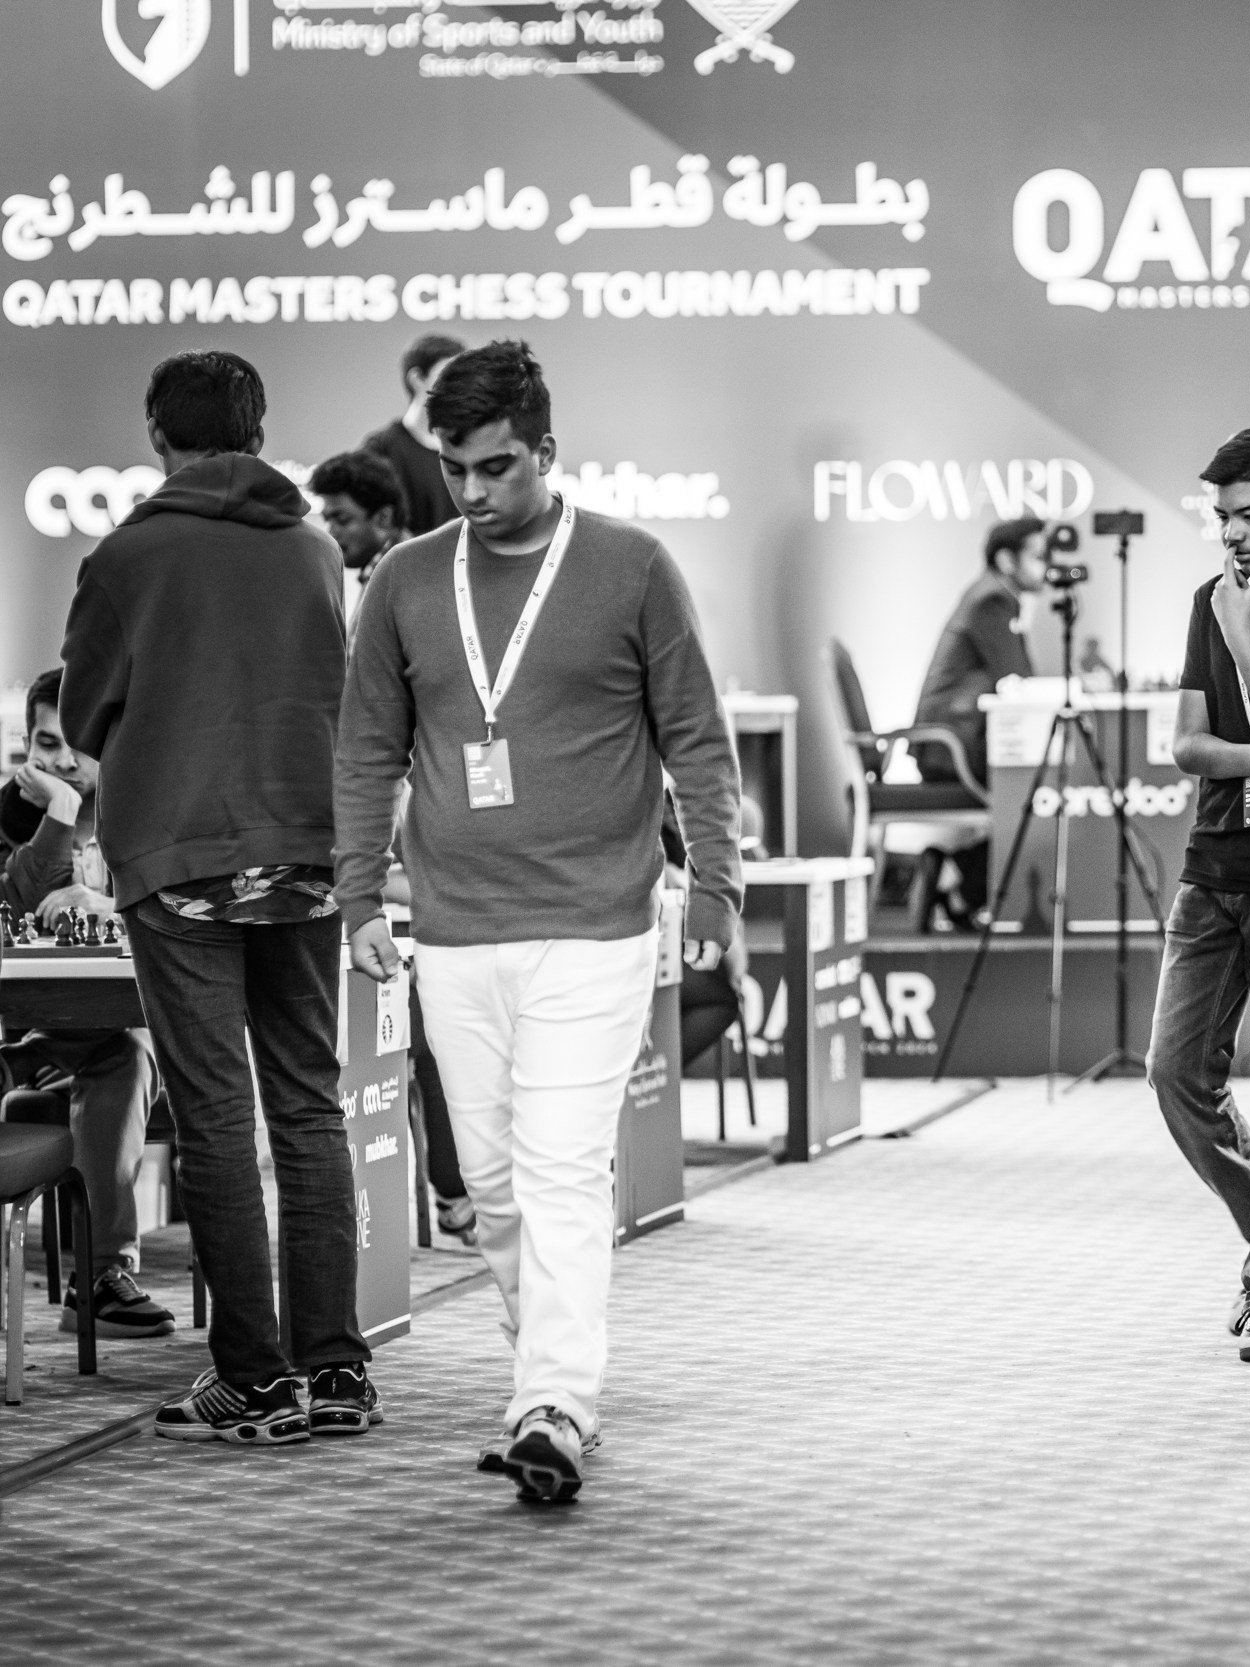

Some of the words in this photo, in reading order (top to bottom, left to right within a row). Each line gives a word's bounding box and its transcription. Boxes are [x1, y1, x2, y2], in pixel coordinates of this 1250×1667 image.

[272, 16, 387, 56] Ministry
[387, 12, 422, 48] of
[422, 12, 520, 54] Sports
[520, 10, 576, 46] and
[576, 10, 664, 45] Youth
[2, 278, 164, 328] QATAR
[169, 274, 398, 325] MASTERS
[402, 272, 570, 321] CHESS
[571, 267, 931, 319] TOURNAMENT
[813, 459, 1095, 522] FLOWARD
[465, 635, 479, 661] QATAR
[515, 620, 528, 645] QATAR
